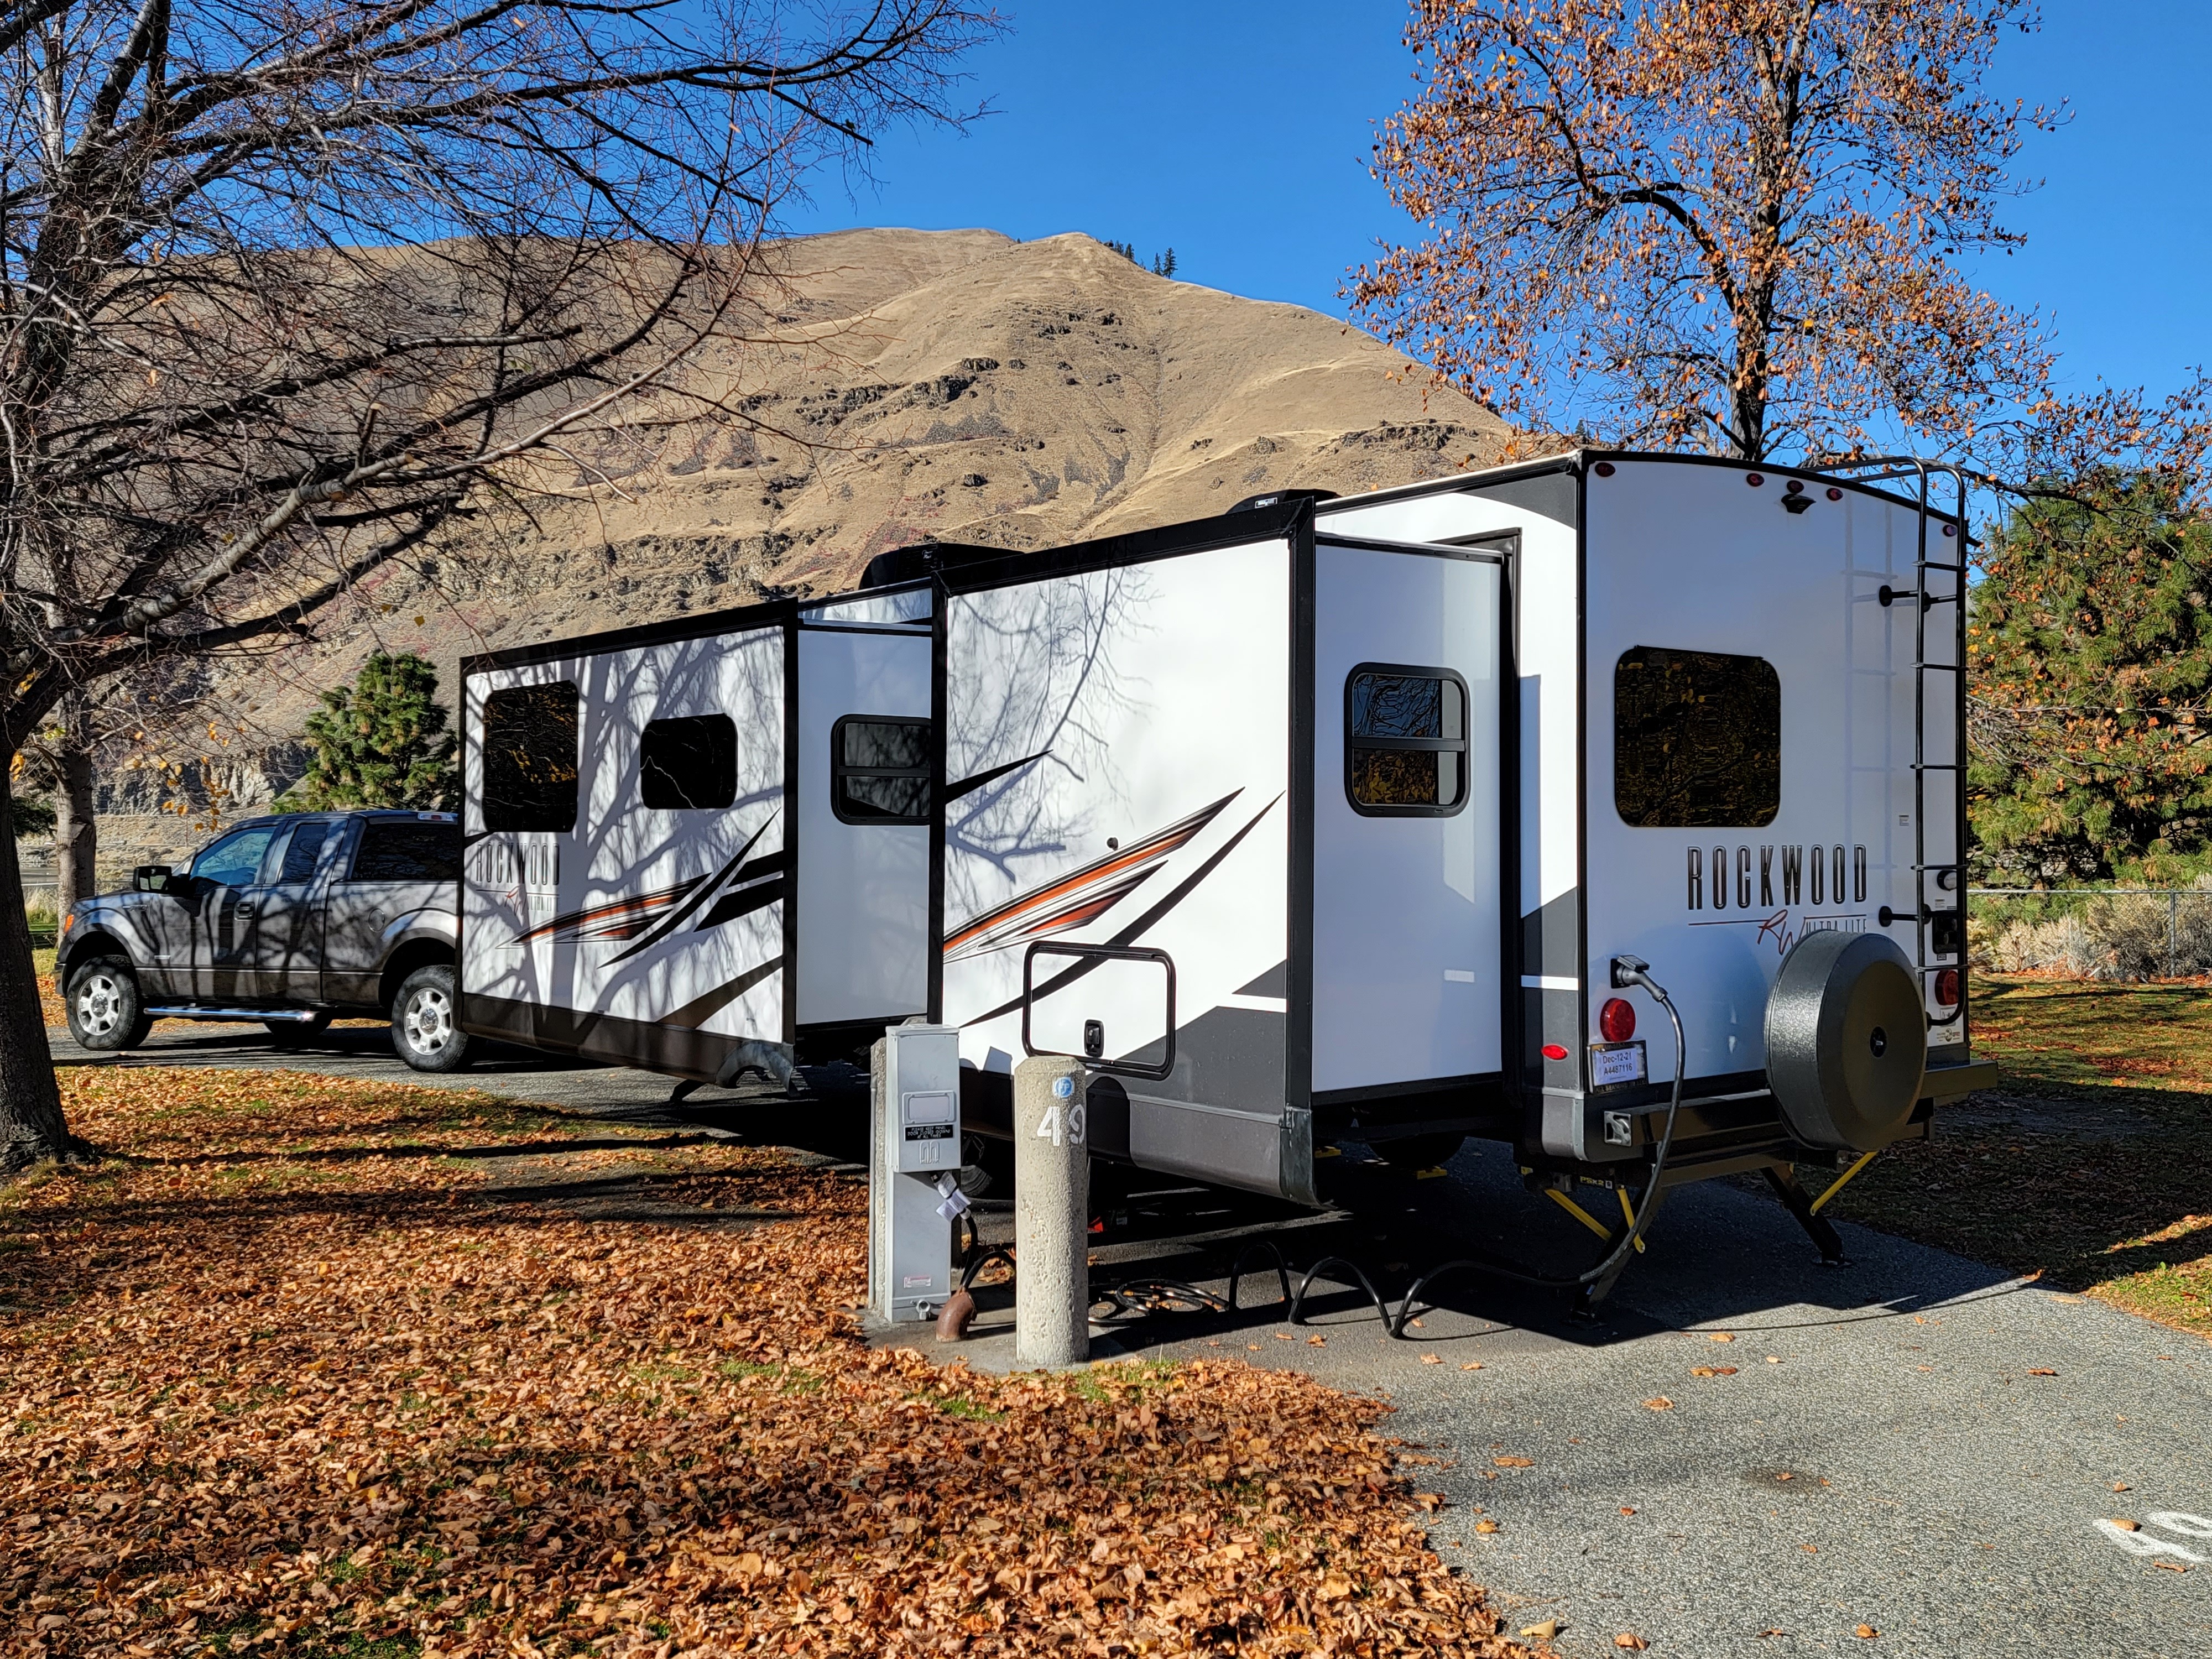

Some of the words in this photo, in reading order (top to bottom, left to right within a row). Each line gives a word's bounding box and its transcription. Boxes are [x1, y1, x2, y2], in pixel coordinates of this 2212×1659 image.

[476, 843, 559, 885] ROCKWOOD
[1687, 844, 1867, 910] ROCKWOOD
[1603, 1051, 1632, 1064] Dec-12-21
[1604, 1062, 1633, 1076] A4487116
[1037, 1103, 1085, 1146] 49
